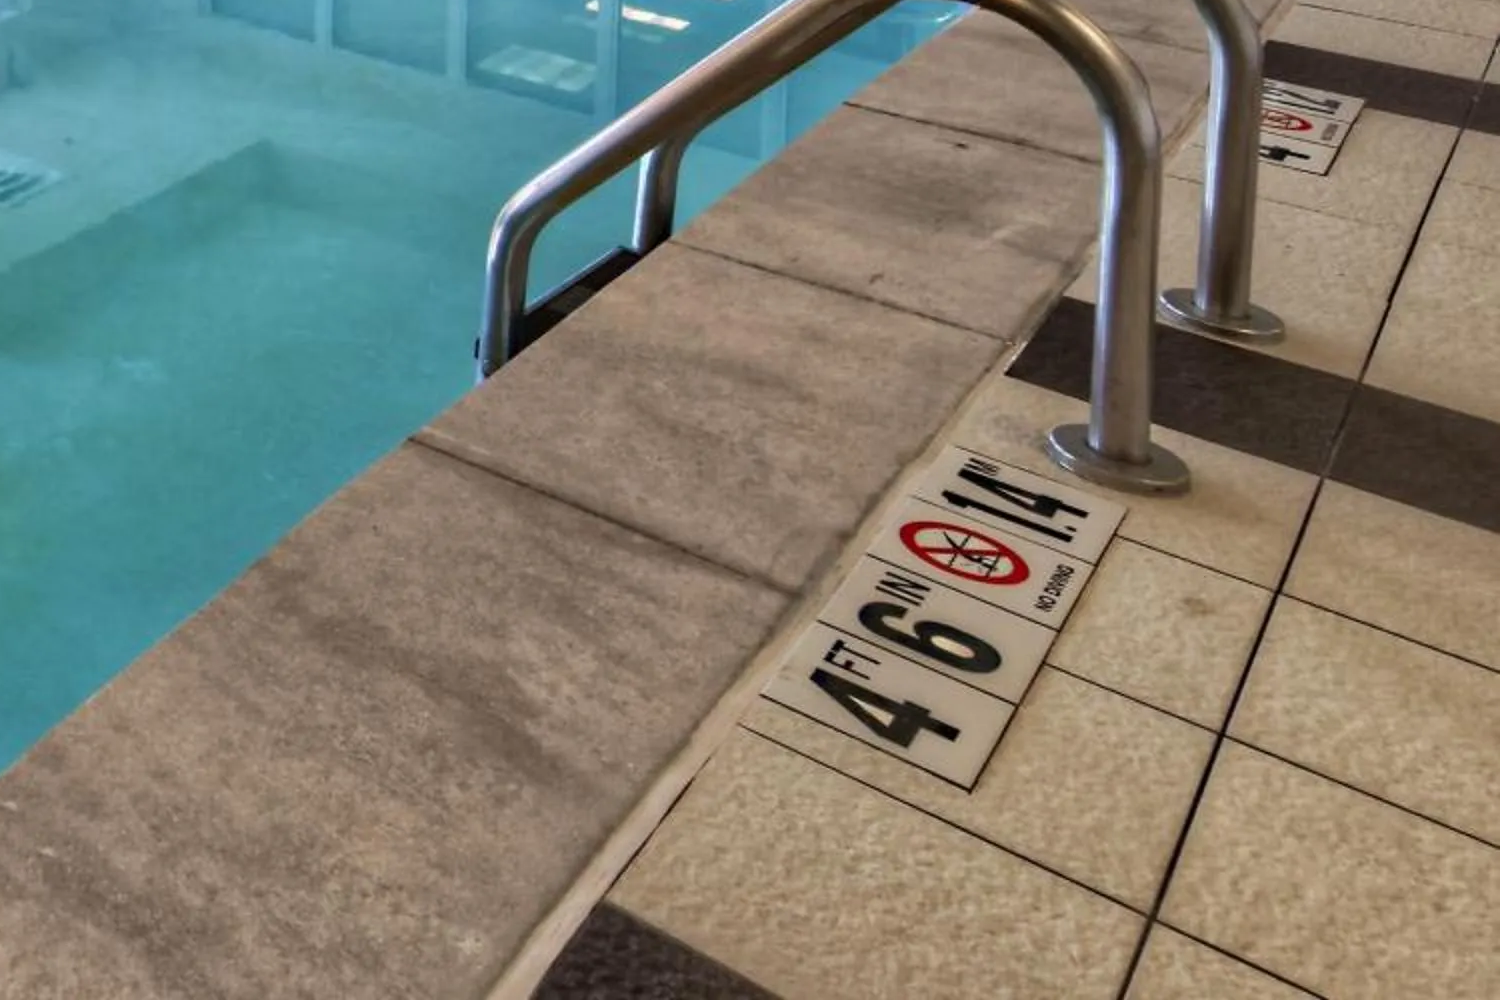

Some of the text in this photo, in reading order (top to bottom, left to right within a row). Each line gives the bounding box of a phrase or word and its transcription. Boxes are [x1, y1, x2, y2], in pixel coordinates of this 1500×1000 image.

[875, 571, 931, 607] IN
[1033, 564, 1074, 612] NO DIVING
[823, 639, 882, 680] FT
[858, 602, 1002, 674] 6
[809, 667, 961, 748] 4
